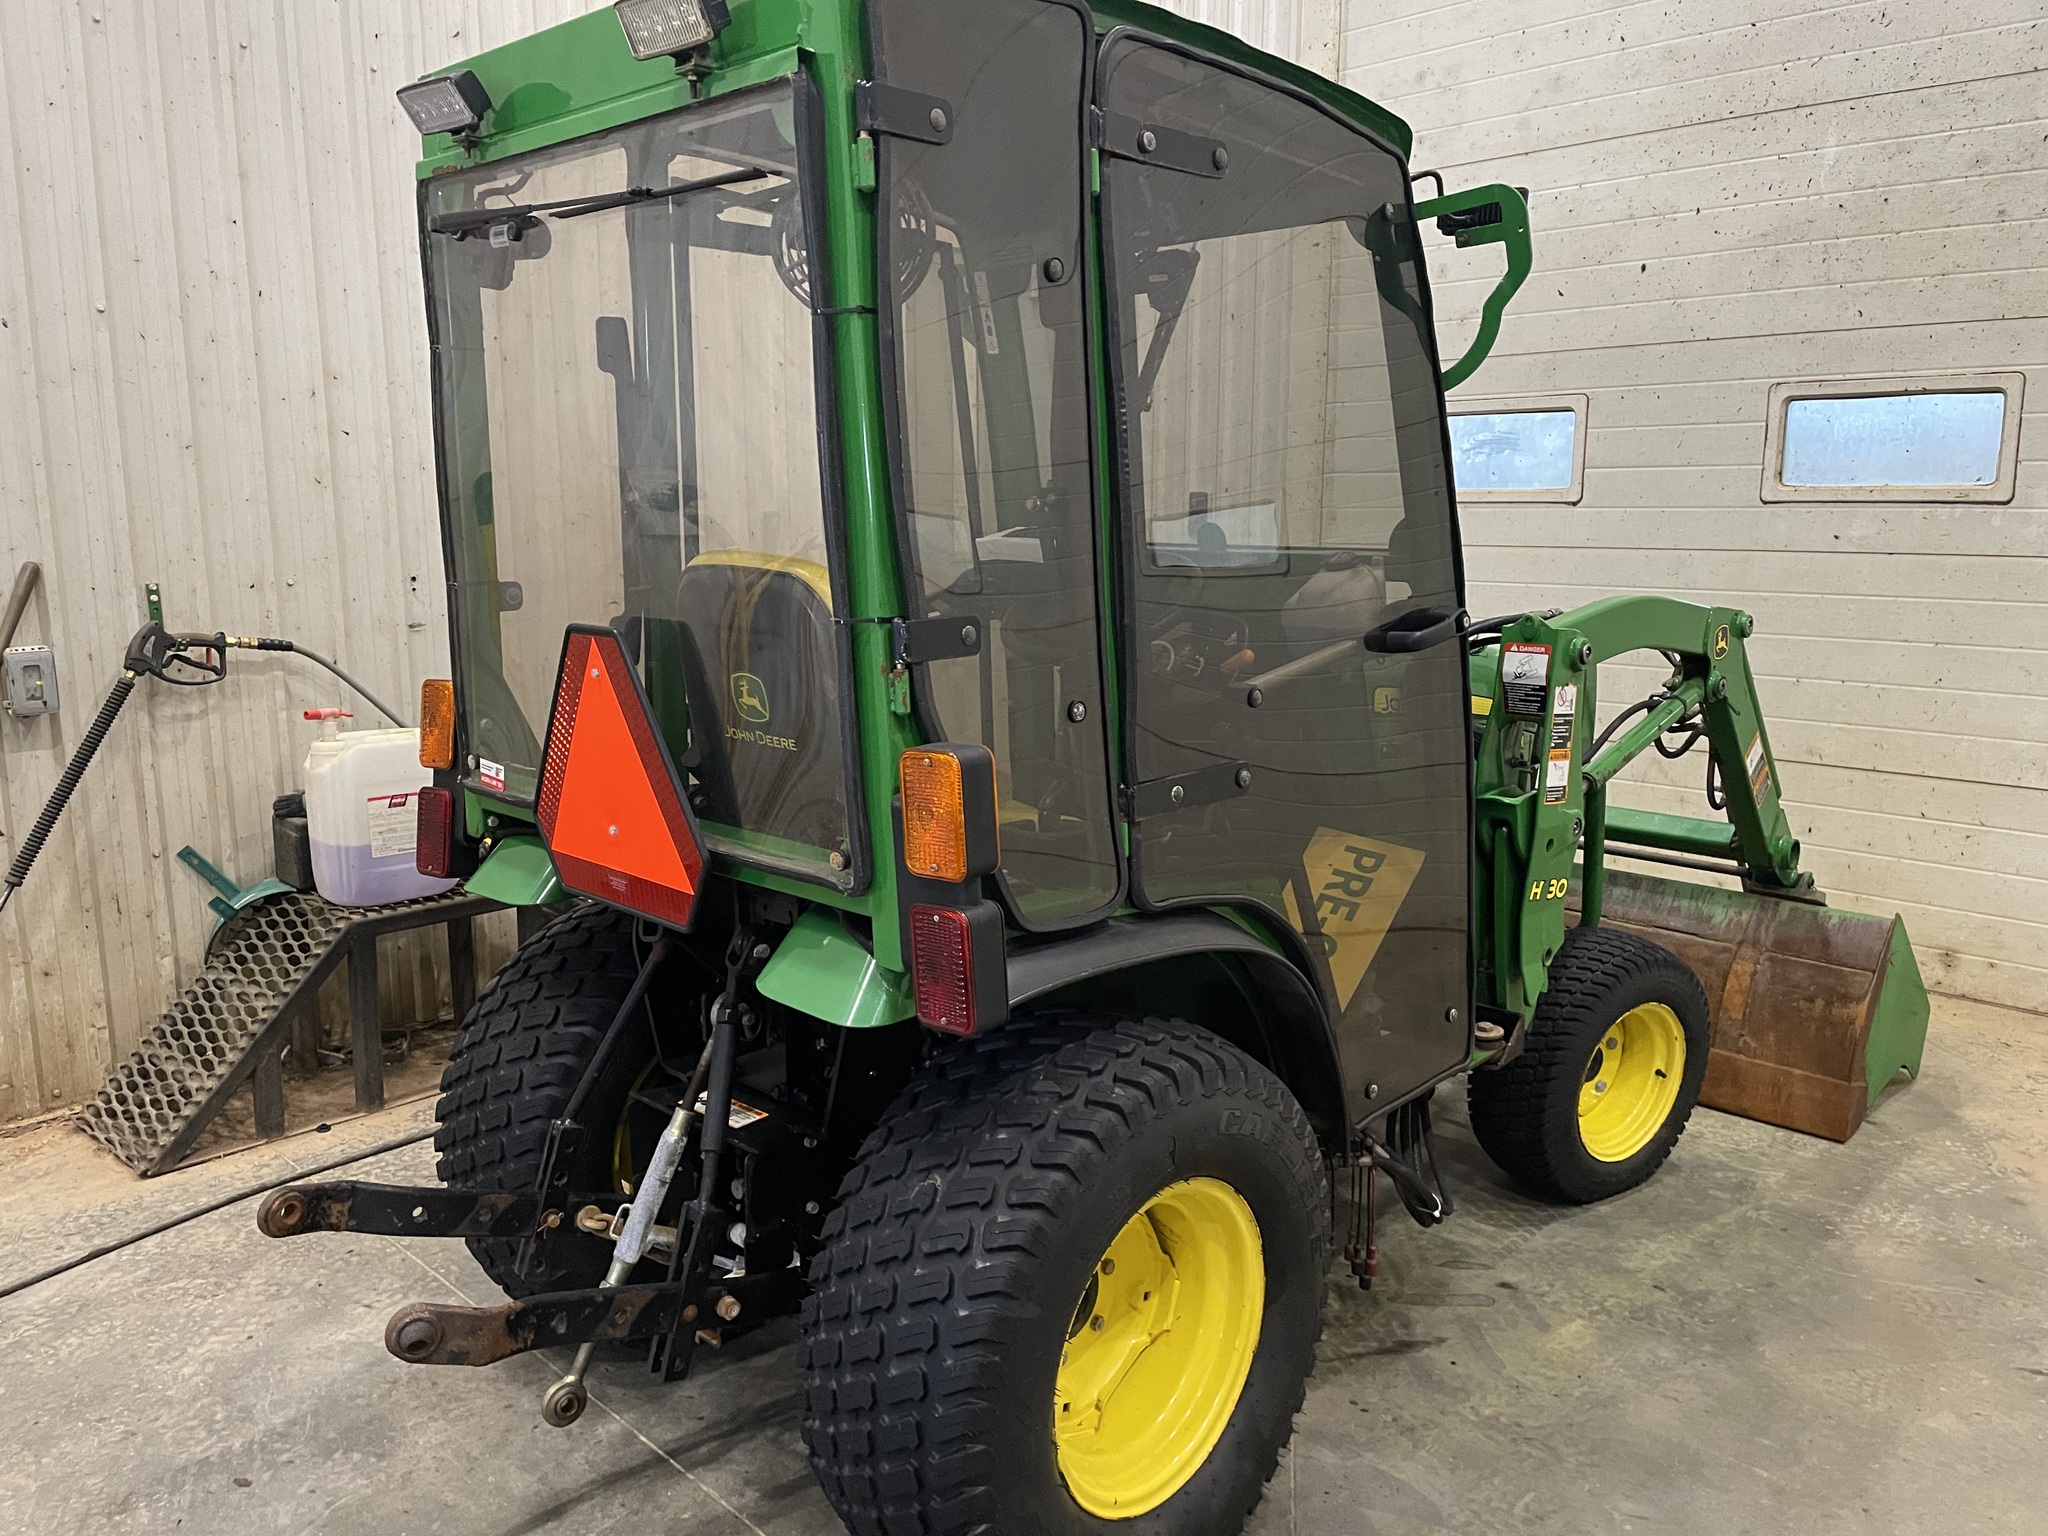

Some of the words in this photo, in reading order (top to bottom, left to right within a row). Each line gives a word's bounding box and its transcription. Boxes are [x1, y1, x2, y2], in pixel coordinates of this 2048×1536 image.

[1519, 645, 1546, 653] DANGER
[724, 724, 755, 742] JOHN
[755, 730, 798, 751] DEERE
[1529, 880, 1545, 901] H
[1546, 878, 1568, 900] 30
